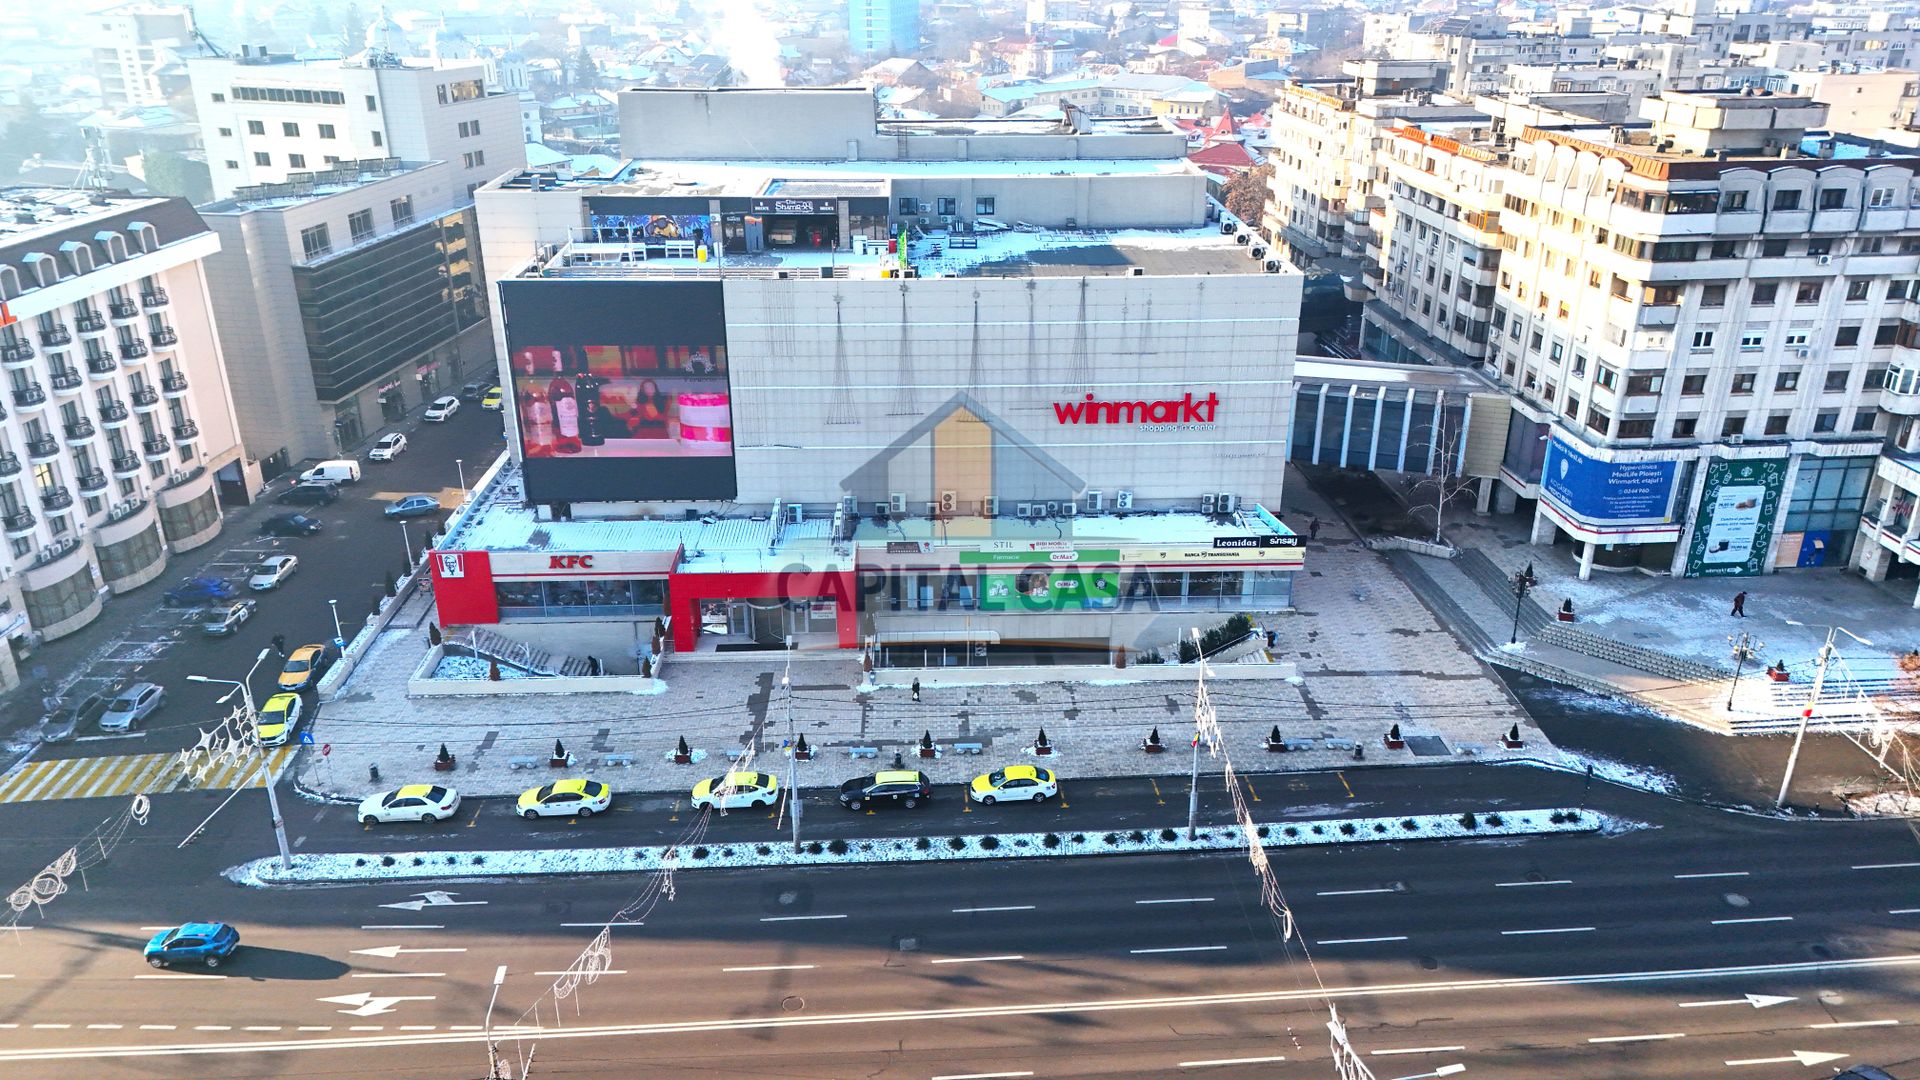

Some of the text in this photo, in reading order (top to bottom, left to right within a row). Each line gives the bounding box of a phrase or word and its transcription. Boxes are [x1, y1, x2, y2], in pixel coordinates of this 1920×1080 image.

[1053, 392, 1219, 425] winmarkt
[1139, 425, 1177, 433] shopping
[993, 541, 1014, 549] STIL
[1216, 539, 1257, 547] Leonidas
[1269, 536, 1298, 547] sinsay
[548, 555, 593, 569] KFC
